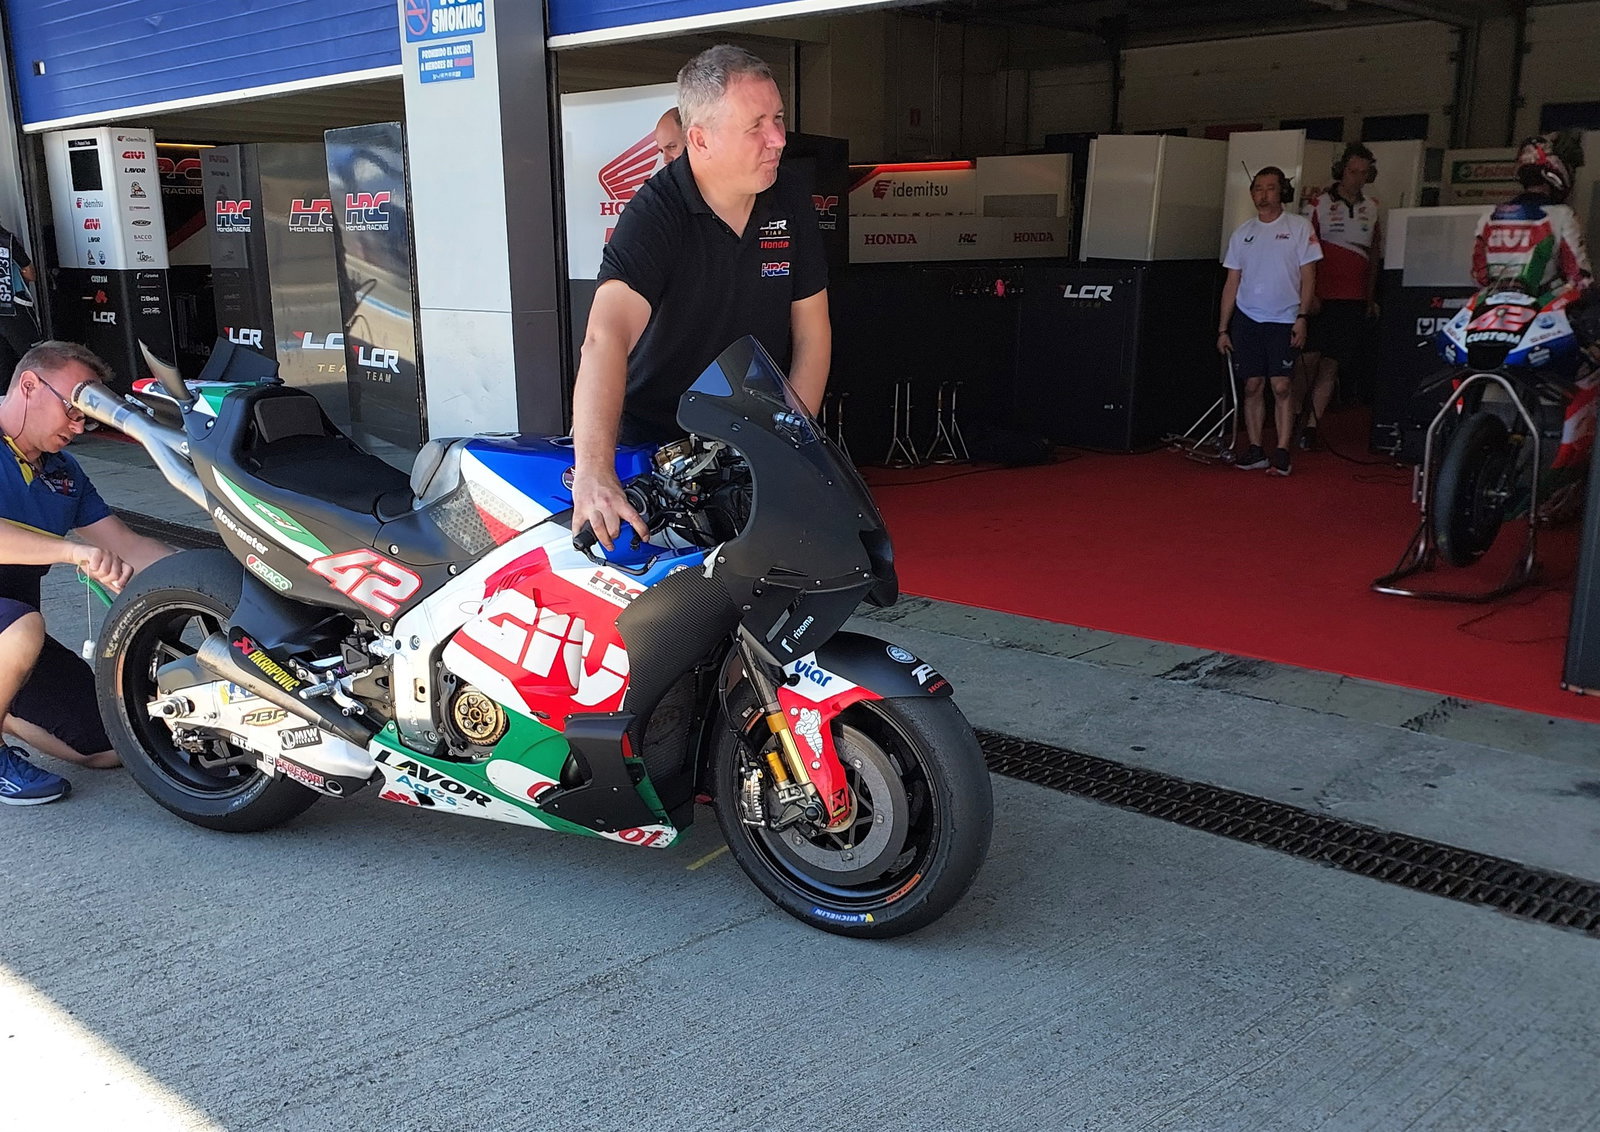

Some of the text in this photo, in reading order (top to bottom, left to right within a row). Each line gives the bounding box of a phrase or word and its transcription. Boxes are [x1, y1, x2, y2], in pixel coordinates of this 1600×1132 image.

[431, 2, 483, 34] SMOKING
[122, 151, 146, 159] GIVI
[892, 181, 949, 198] idemitsu
[216, 200, 252, 227] HRC
[345, 191, 391, 225] HRC
[84, 218, 102, 230] GIVI
[760, 241, 789, 249] Honda
[864, 233, 918, 245] HONDA
[1013, 232, 1054, 243] HONDA
[761, 262, 790, 277] HRC
[1063, 285, 1114, 302] LCR
[93, 311, 117, 325] LCR
[228, 327, 264, 350] LCR
[301, 331, 345, 350] LC
[1466, 331, 1522, 344] CUSTOM
[317, 364, 347, 373] TEA
[357, 346, 400, 374] LCR
[365, 371, 392, 383] TEAM
[214, 506, 269, 555] flow-meter
[252, 561, 290, 591] DRACO
[307, 548, 423, 618] 42
[793, 614, 815, 640] rizoma
[794, 659, 832, 688] viar
[240, 709, 289, 725] PBR
[374, 749, 492, 808] LAVOR
[814, 907, 859, 923] MICHELIN
